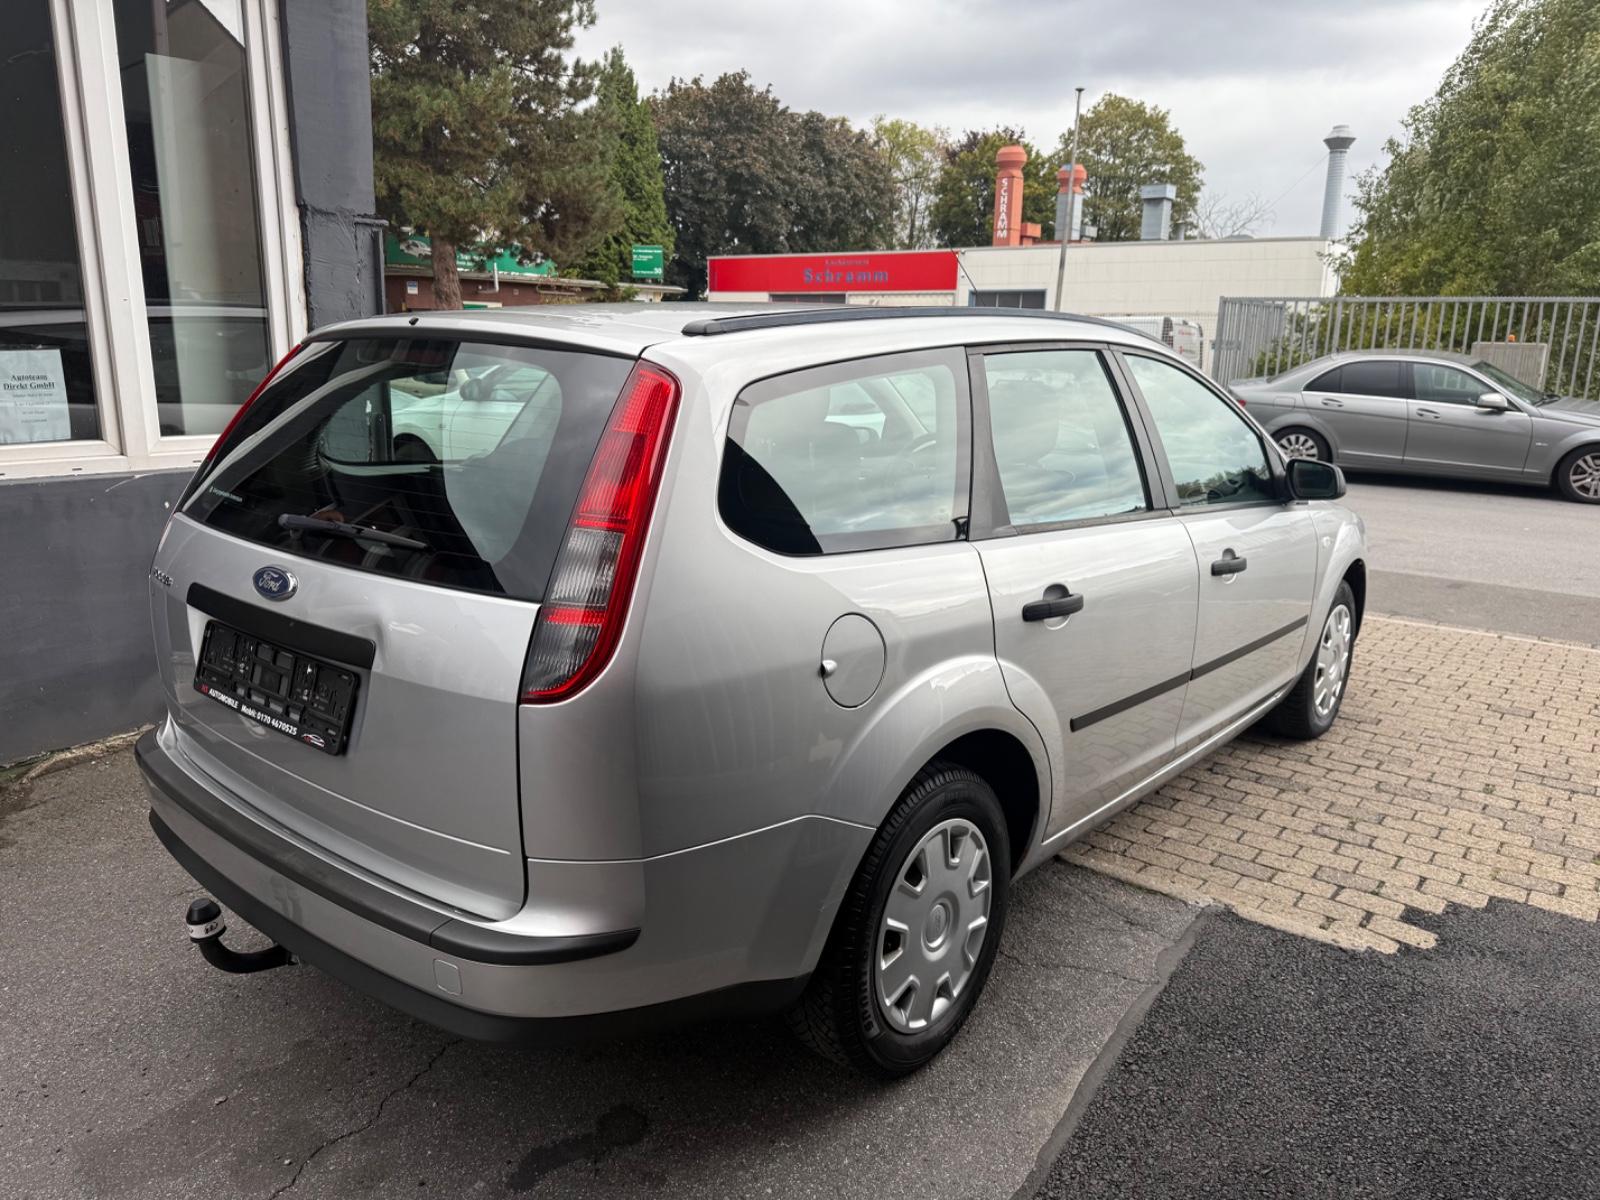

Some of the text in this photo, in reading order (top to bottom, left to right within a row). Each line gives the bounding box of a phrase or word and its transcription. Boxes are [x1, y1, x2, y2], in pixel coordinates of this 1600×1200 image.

[997, 178, 1008, 238] SCHRAMM
[803, 267, 889, 283] Schramm
[3, 382, 55, 390] Direkt GmbH
[258, 570, 284, 592] Ford
[209, 688, 238, 709] AUTOMOBILE
[256, 711, 271, 724] 0170
[271, 717, 298, 736] 4670525
